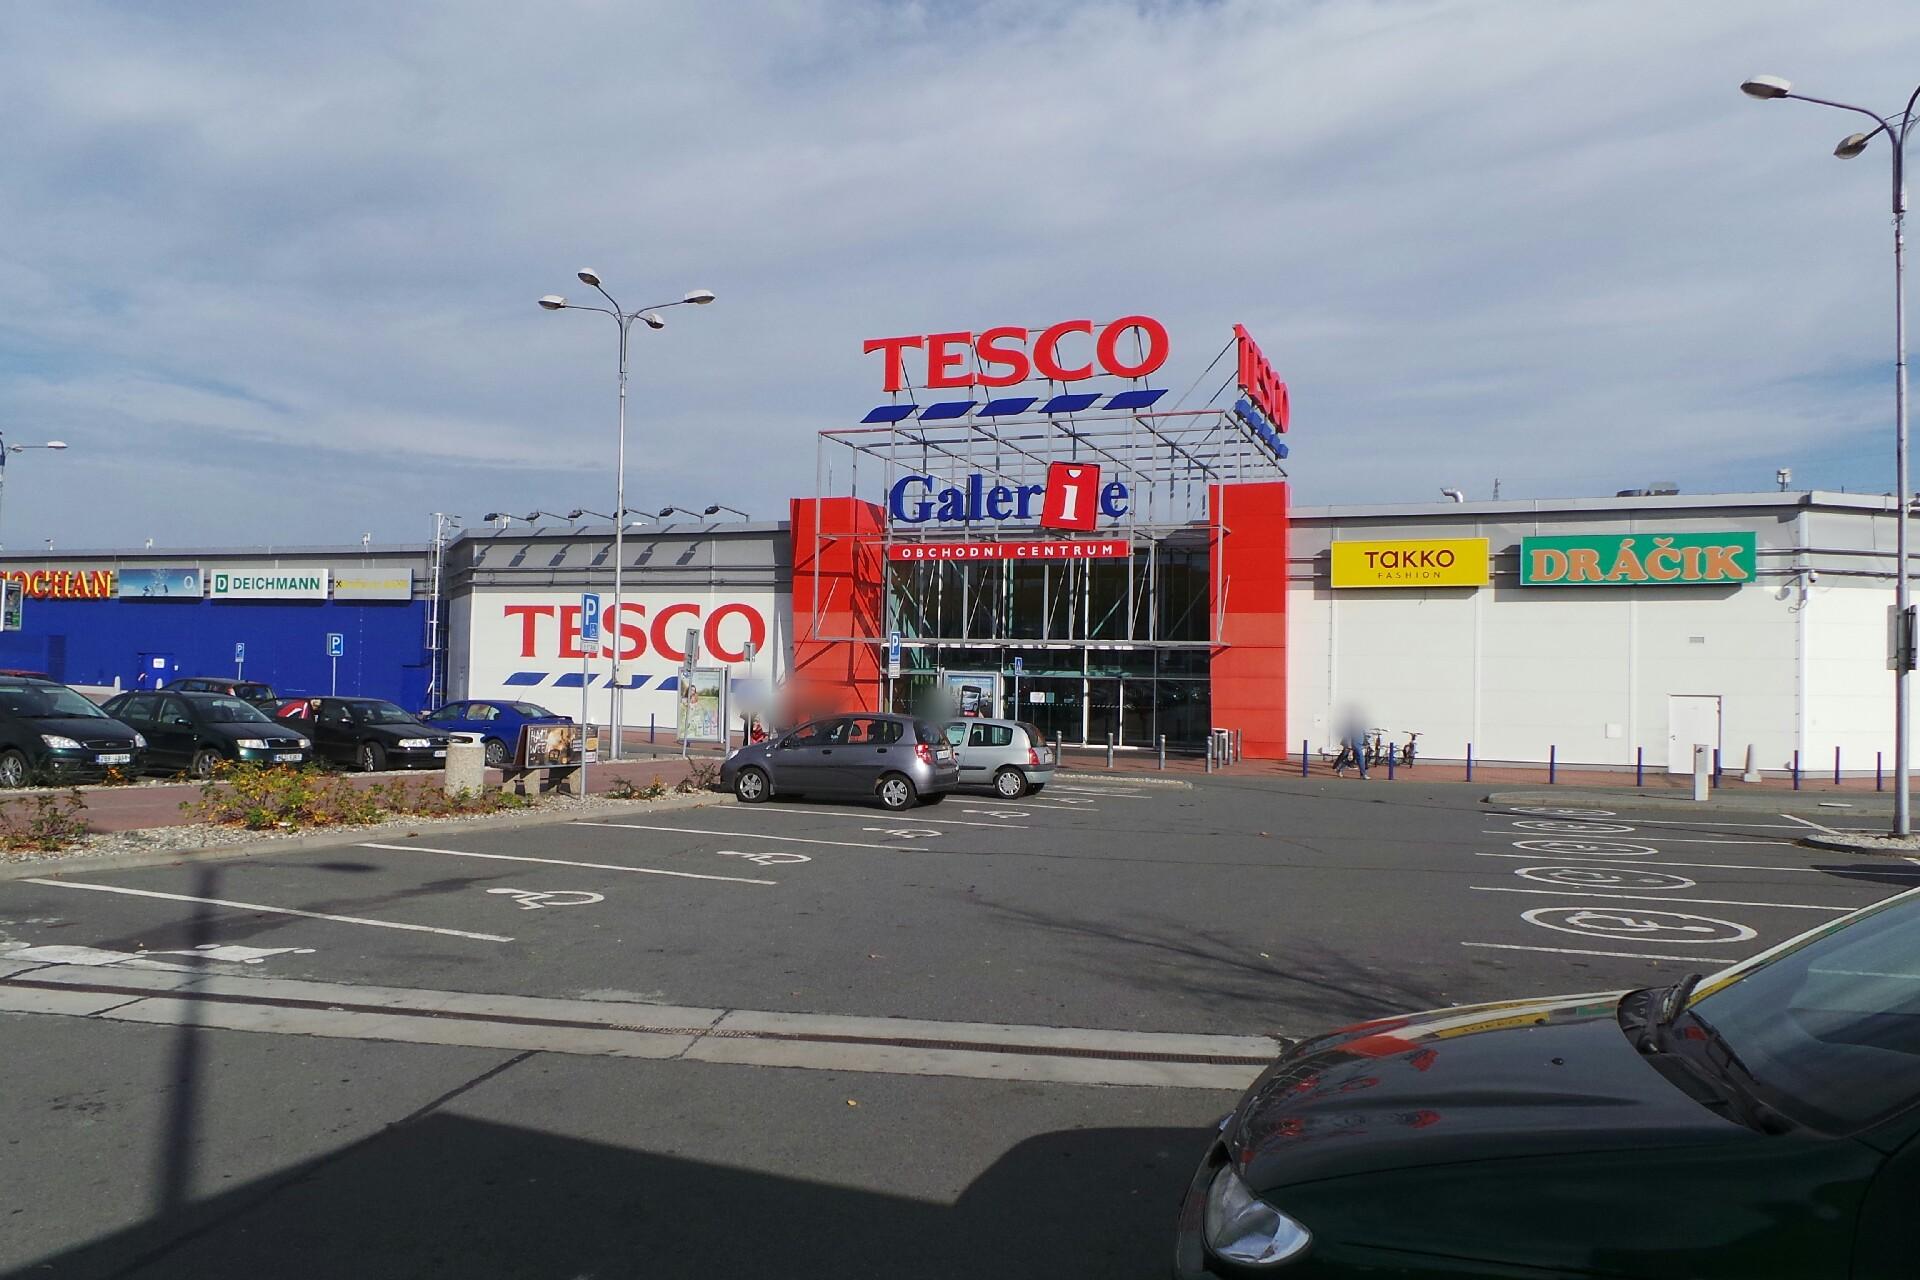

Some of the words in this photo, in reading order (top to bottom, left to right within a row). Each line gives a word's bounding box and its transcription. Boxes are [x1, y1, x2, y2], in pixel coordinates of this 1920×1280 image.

[863, 315, 1169, 392] TESCO
[889, 468, 1129, 524] Galerie
[902, 544, 1003, 559] OBCHODNÍ
[1017, 544, 1113, 557] CENTRUM
[1529, 537, 1748, 581] DRÁČIK
[233, 577, 320, 590] DEICHMANN
[1377, 571, 1441, 579] FASHION
[586, 599, 597, 626] P
[504, 603, 766, 663] TESCO
